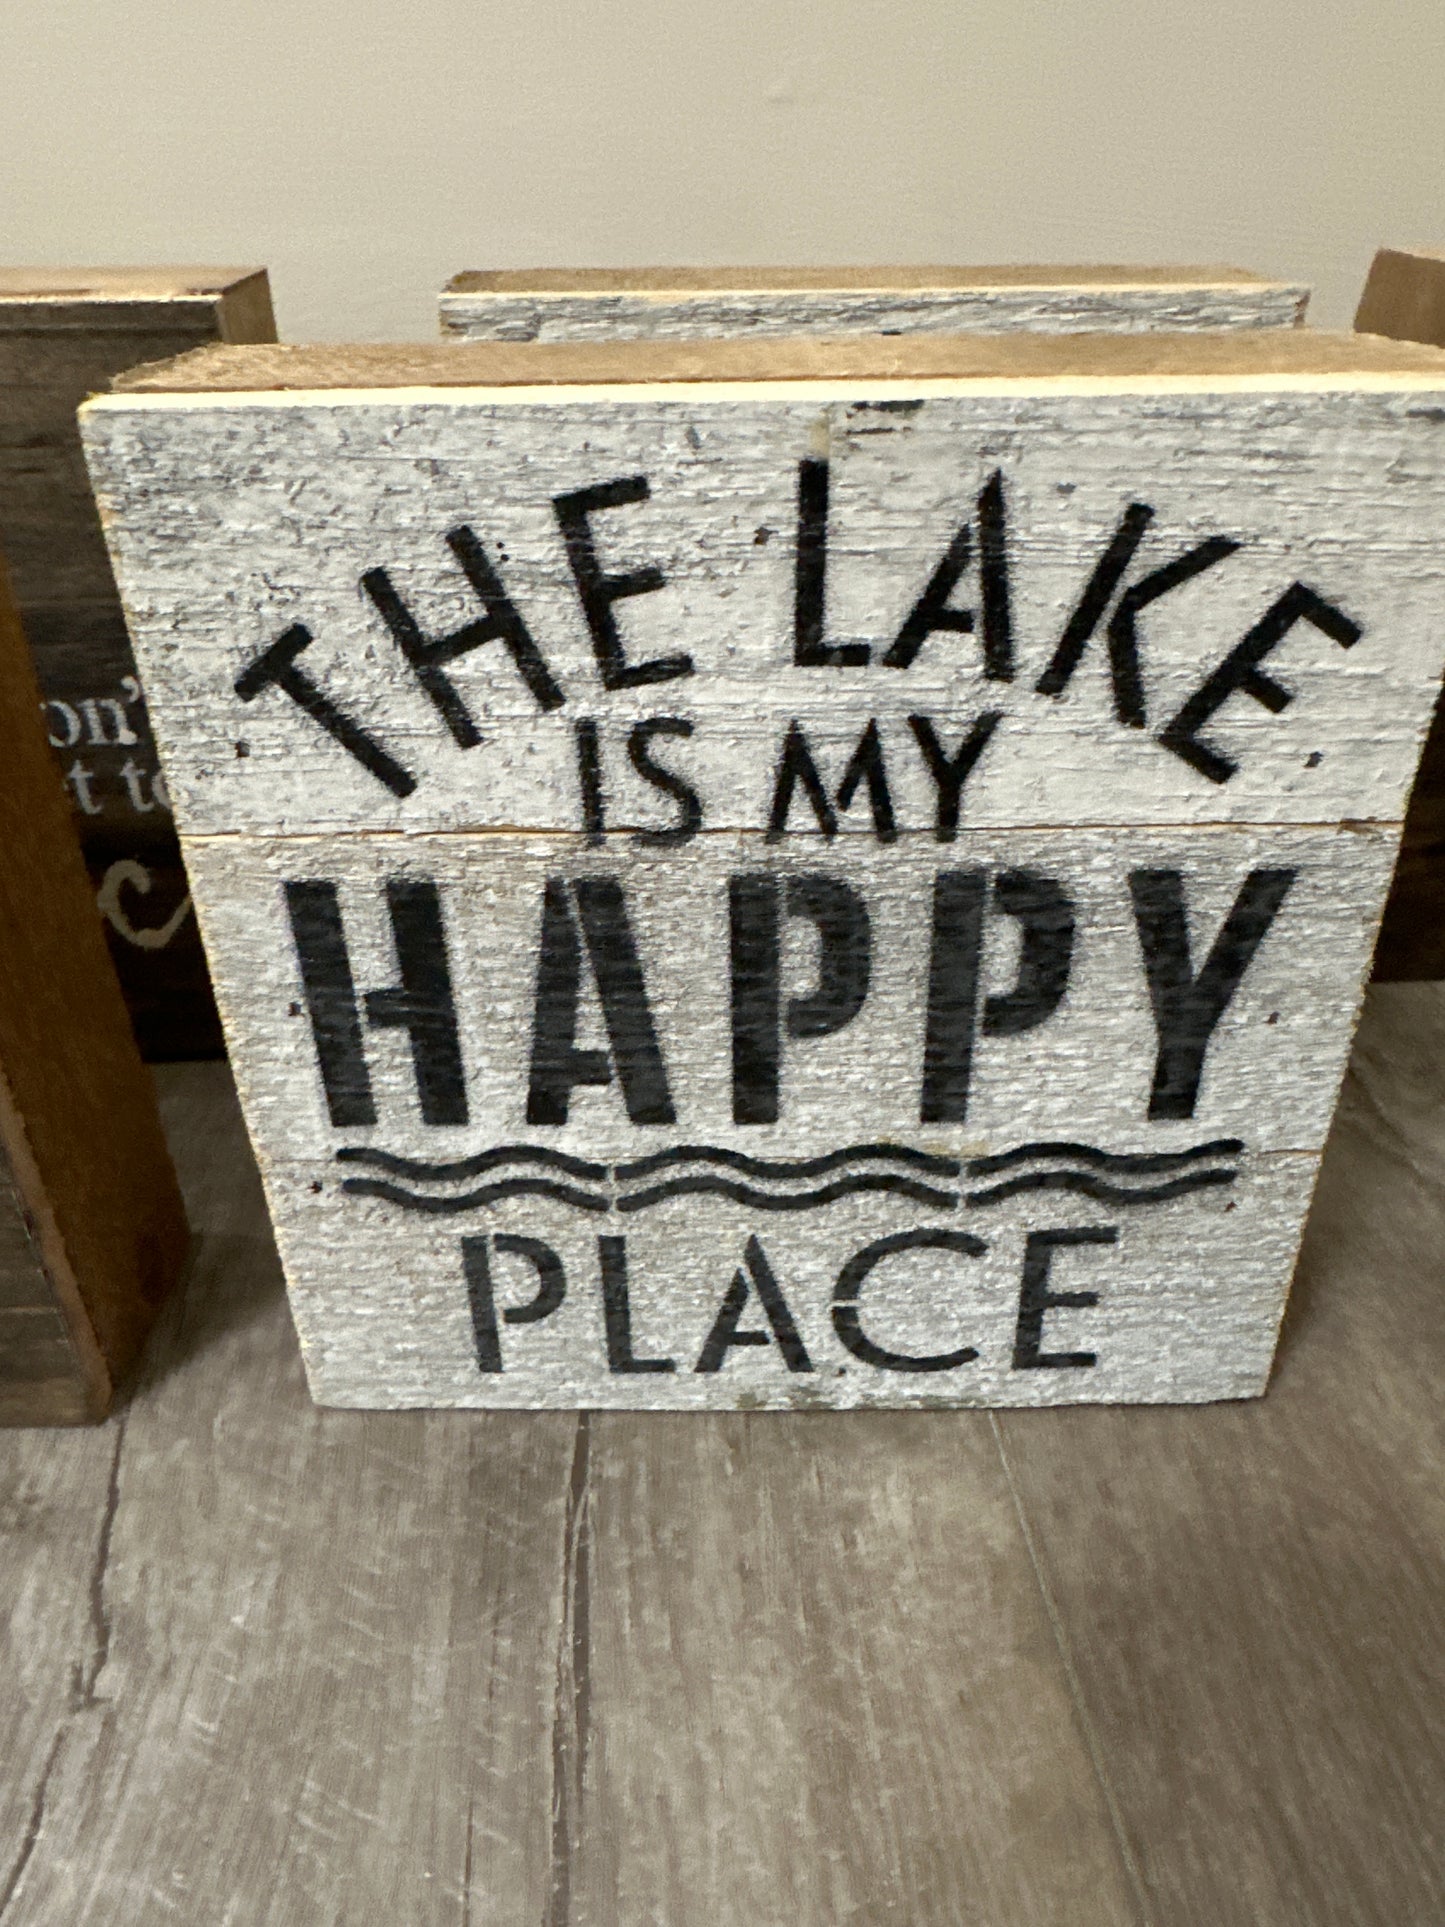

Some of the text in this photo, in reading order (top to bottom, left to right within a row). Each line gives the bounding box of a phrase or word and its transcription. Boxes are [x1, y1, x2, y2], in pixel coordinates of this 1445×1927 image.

[235, 462, 1362, 797] THE LAKE
[576, 712, 1003, 846] IS MY
[283, 868, 1297, 1126] HAPPY
[460, 1226, 1119, 1374] PLACE
